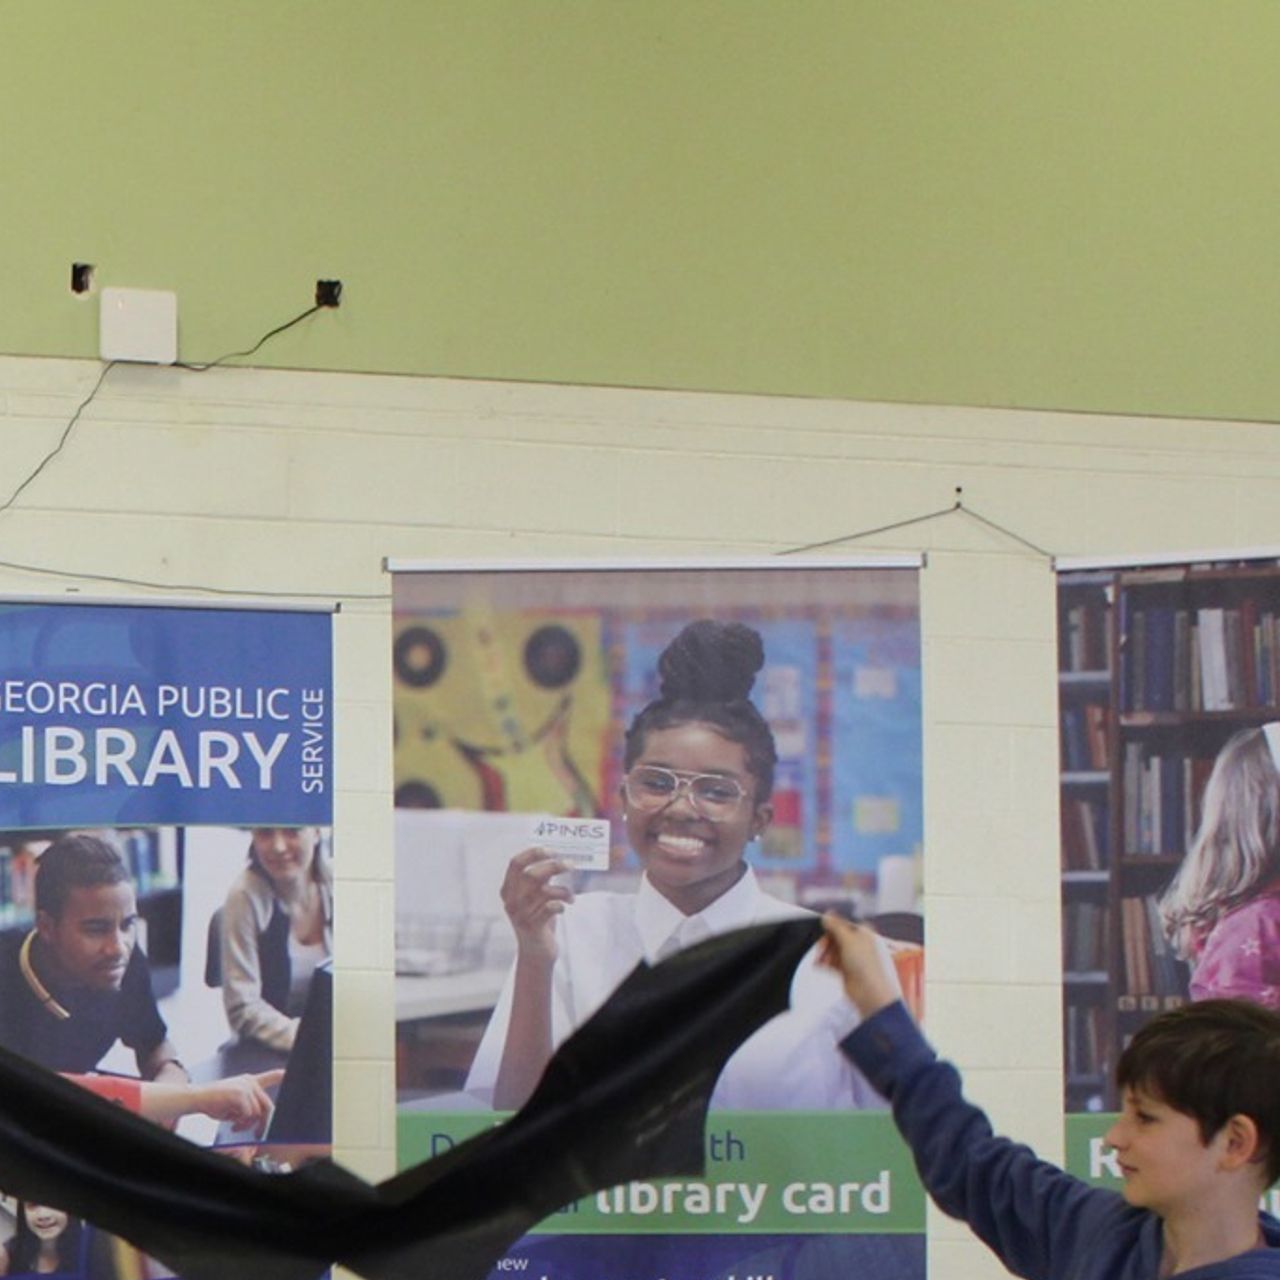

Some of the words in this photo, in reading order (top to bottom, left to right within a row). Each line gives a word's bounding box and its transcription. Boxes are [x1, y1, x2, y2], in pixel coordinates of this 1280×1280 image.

[158, 685, 290, 720] PUBLIC
[301, 688, 324, 794] SERVICE
[709, 1131, 745, 1162] th
[781, 1170, 893, 1214] card
